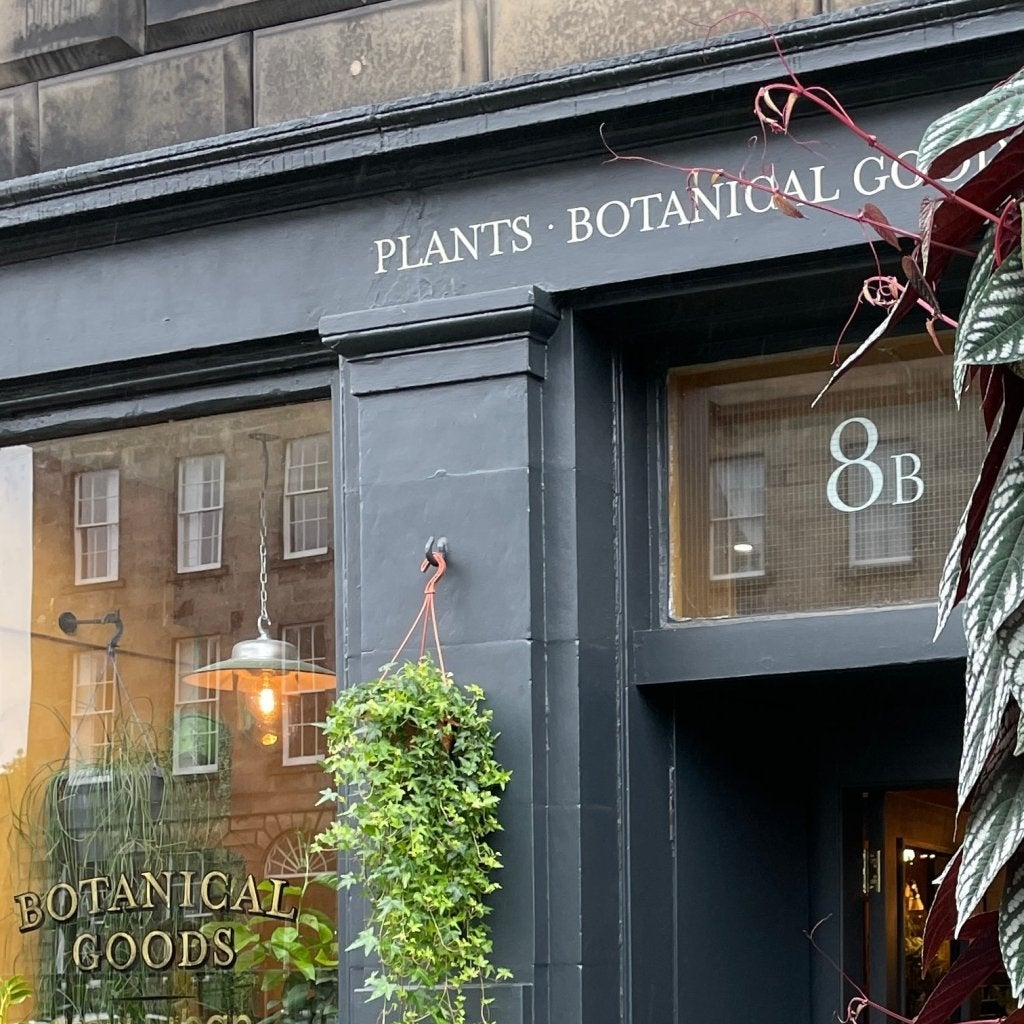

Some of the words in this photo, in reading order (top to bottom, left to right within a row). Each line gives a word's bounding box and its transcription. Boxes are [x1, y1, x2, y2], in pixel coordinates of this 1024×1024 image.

[374, 213, 533, 274] PLANTS
[567, 165, 841, 245] BOTANICAL
[853, 139, 1007, 196] GOO
[826, 416, 925, 512] 8B
[14, 870, 298, 932] BOTANICAL
[72, 926, 237, 972] GOODS
